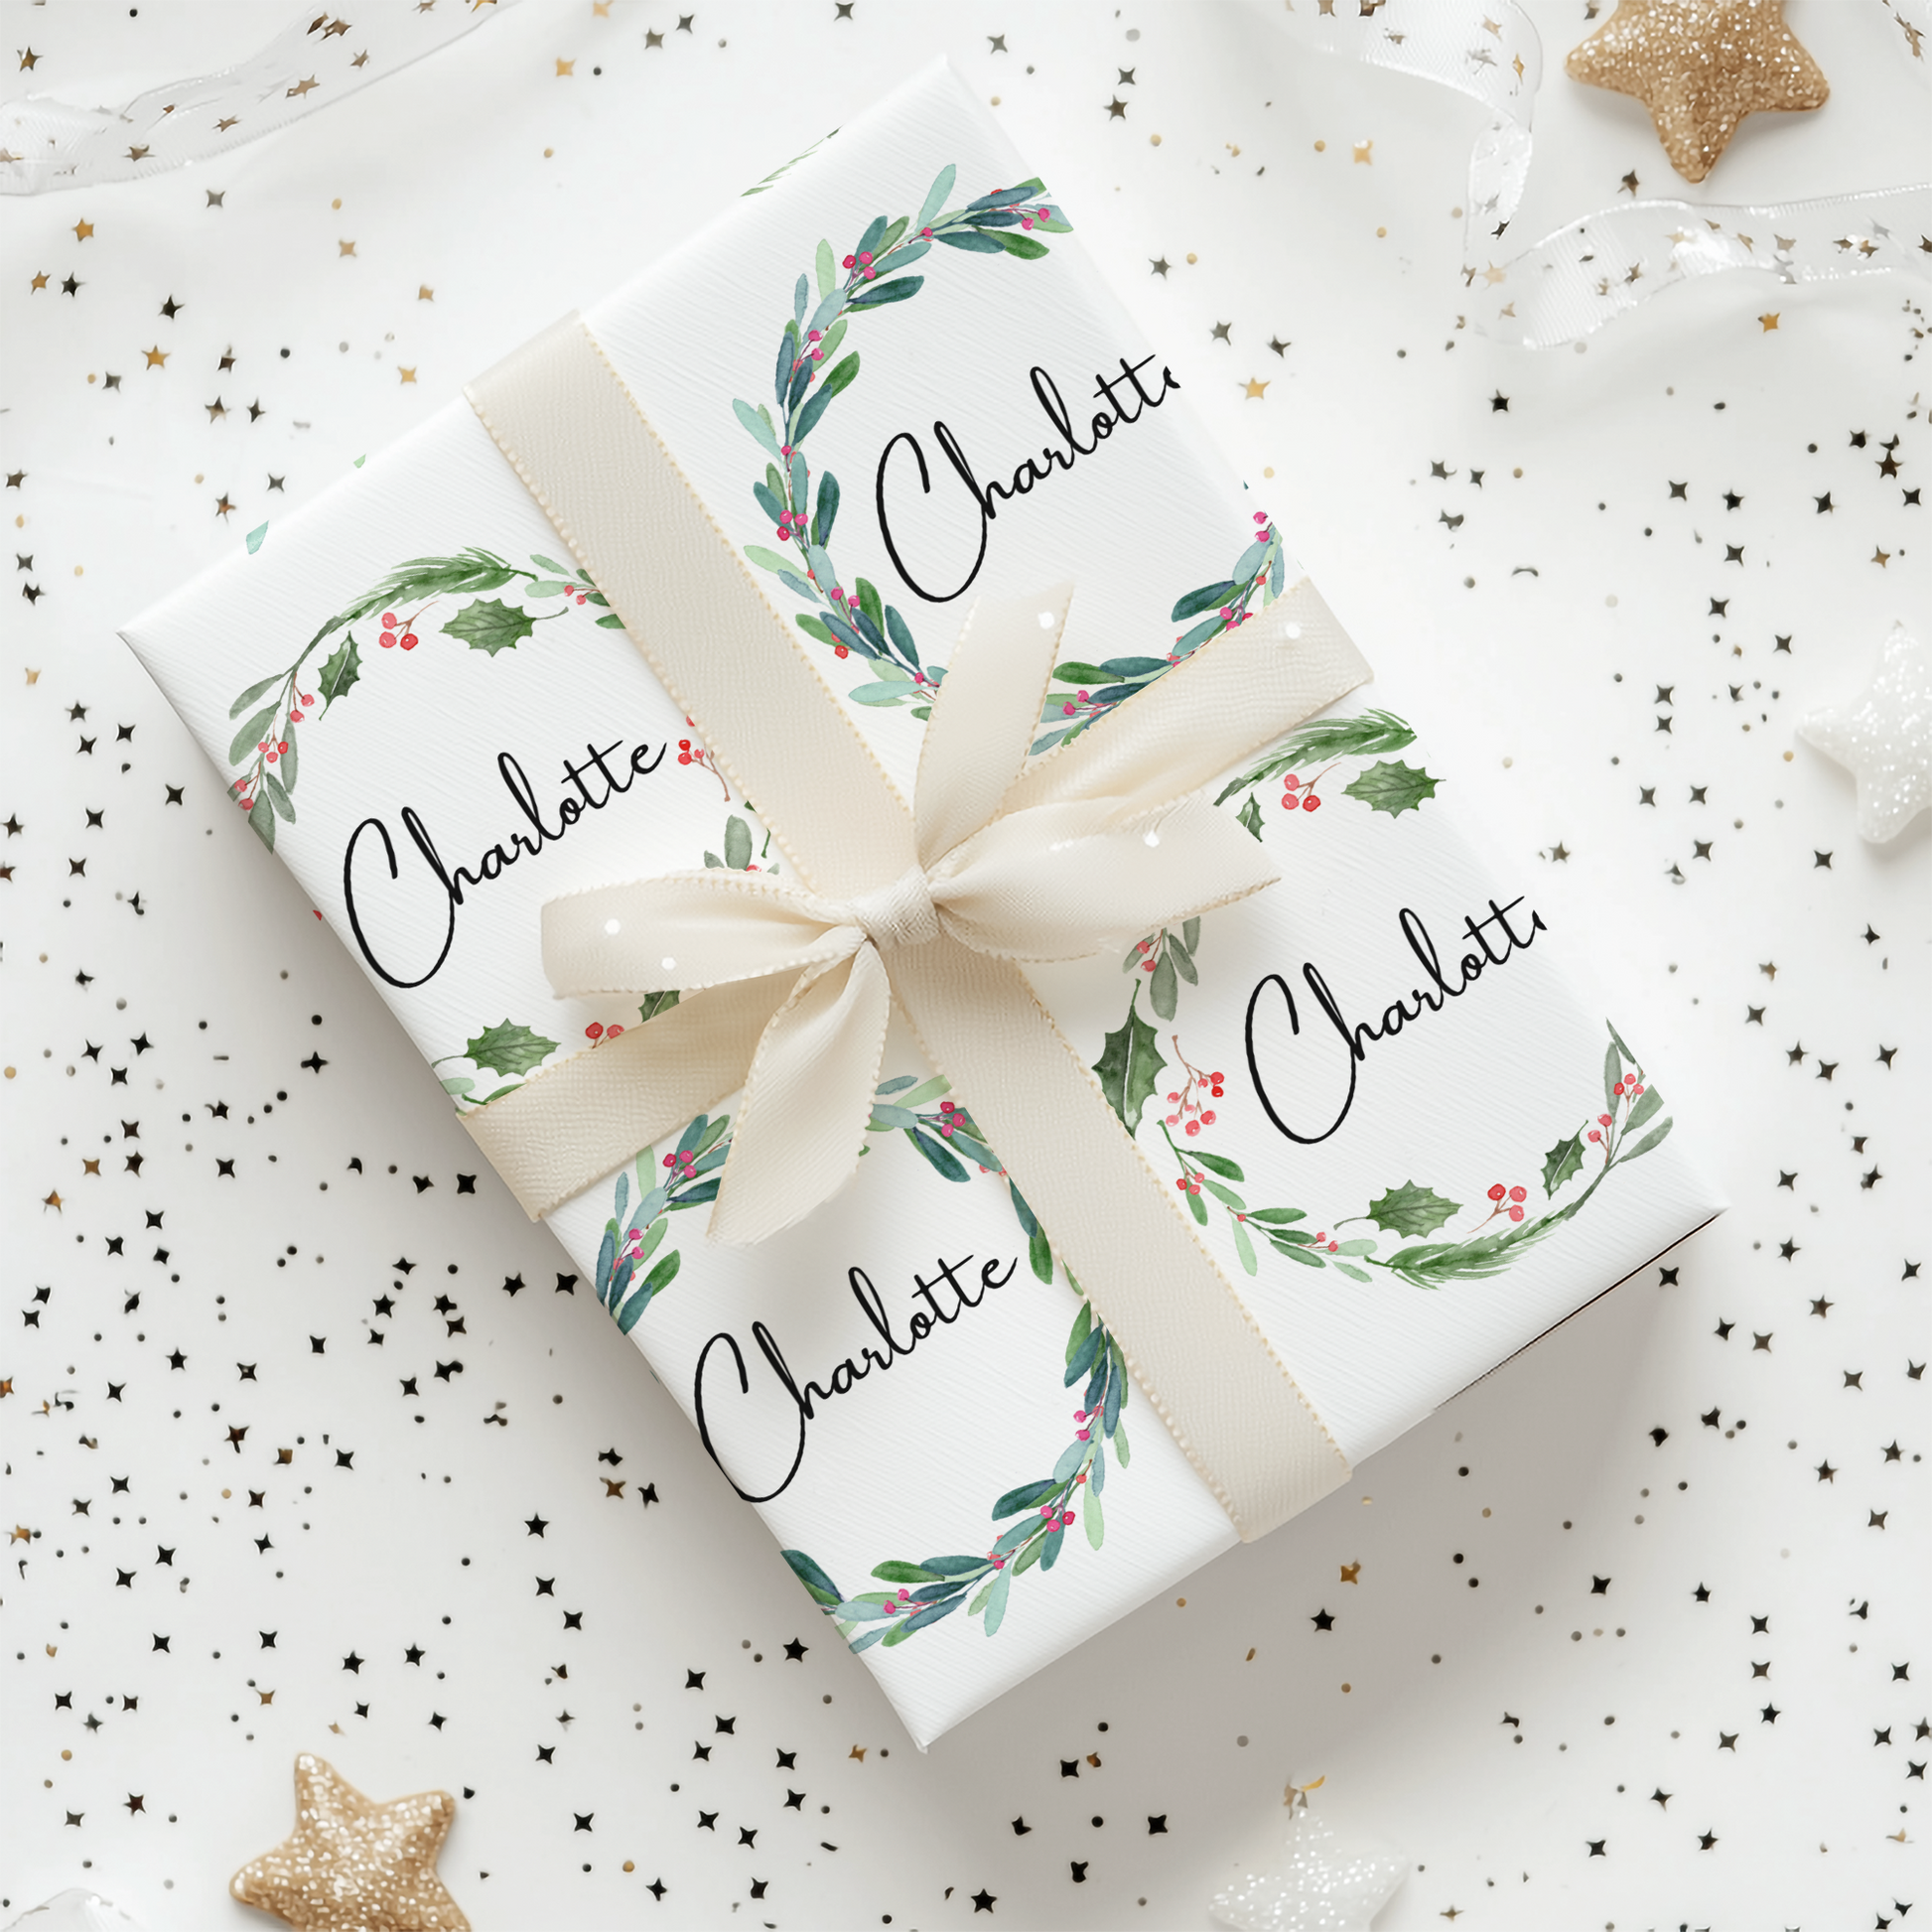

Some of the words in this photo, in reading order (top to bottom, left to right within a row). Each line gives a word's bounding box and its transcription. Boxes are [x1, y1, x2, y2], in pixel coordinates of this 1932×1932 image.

[343, 740, 668, 989] Charlotte
[1244, 896, 1549, 1145] Charlott
[694, 1254, 1019, 1503] Charlotte
